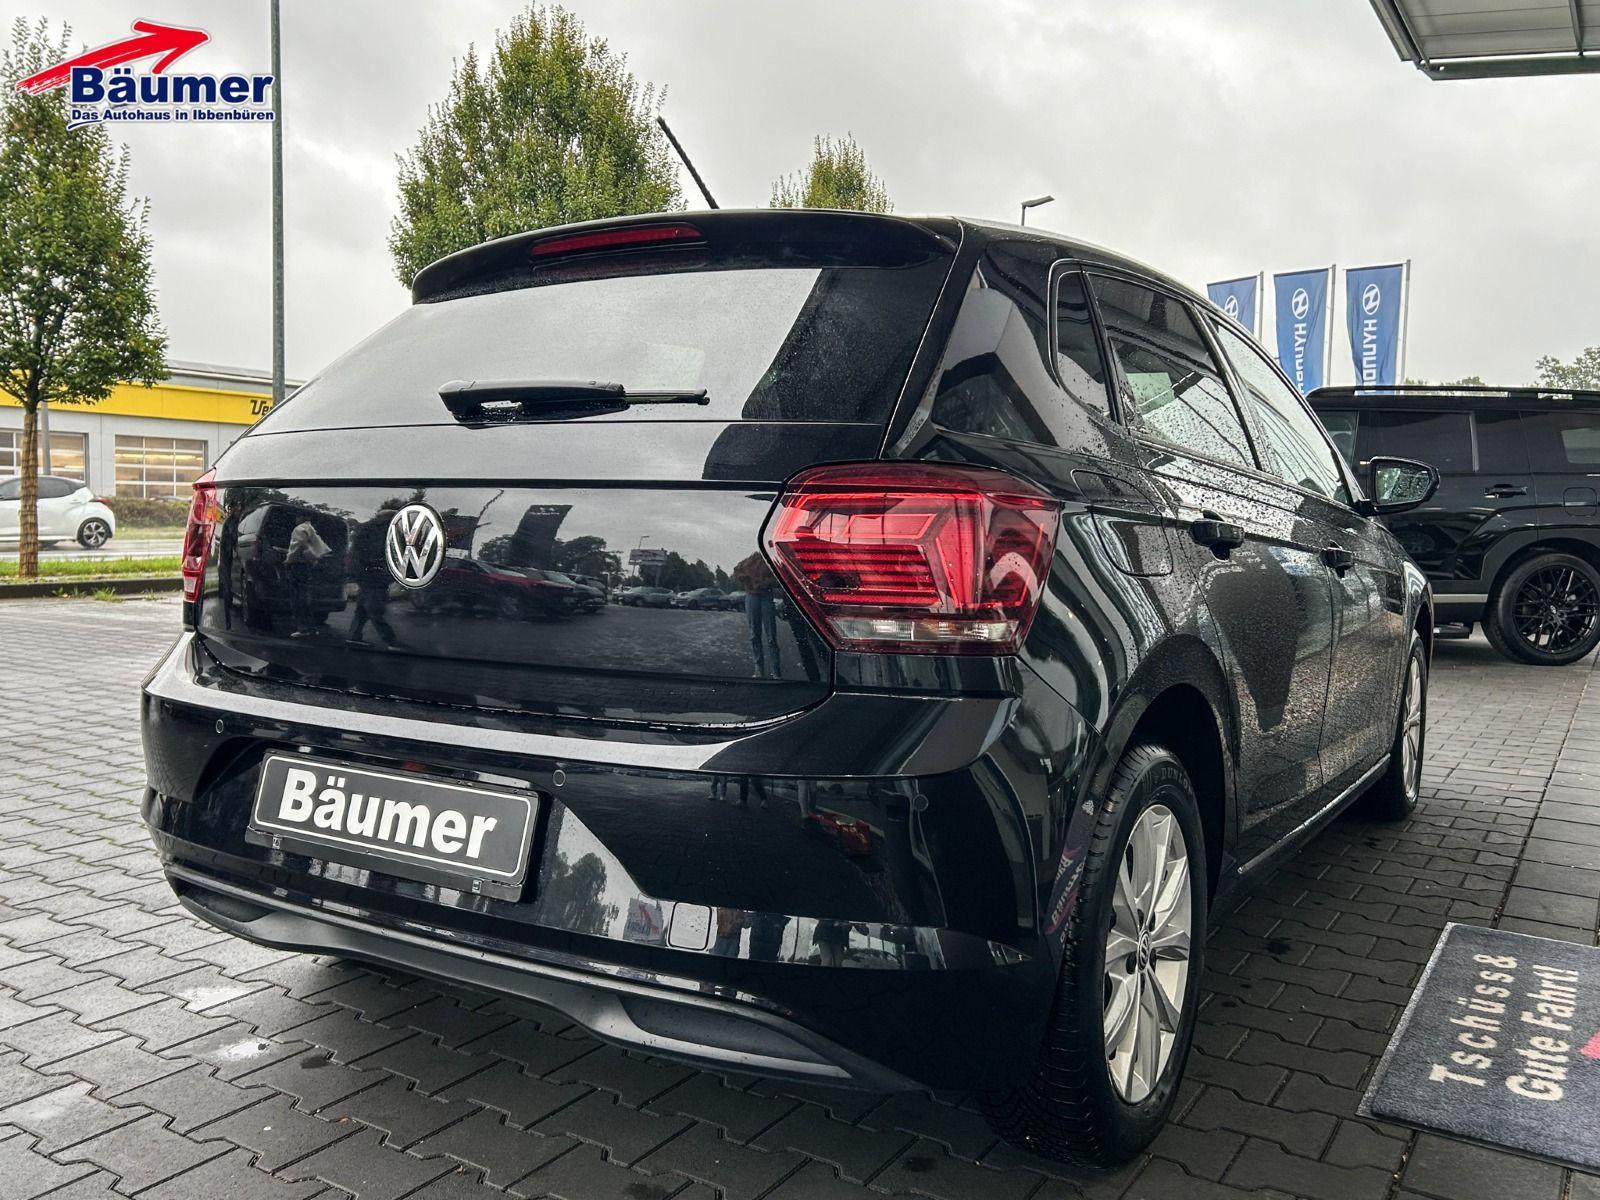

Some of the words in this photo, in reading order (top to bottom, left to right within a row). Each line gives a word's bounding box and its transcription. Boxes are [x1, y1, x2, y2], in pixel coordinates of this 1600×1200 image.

[1294, 323, 1307, 393] HYUNDA
[278, 767, 497, 859] Bäumer
[1521, 965, 1579, 1032] Fahrt!
[1505, 1036, 1570, 1101] Gute
